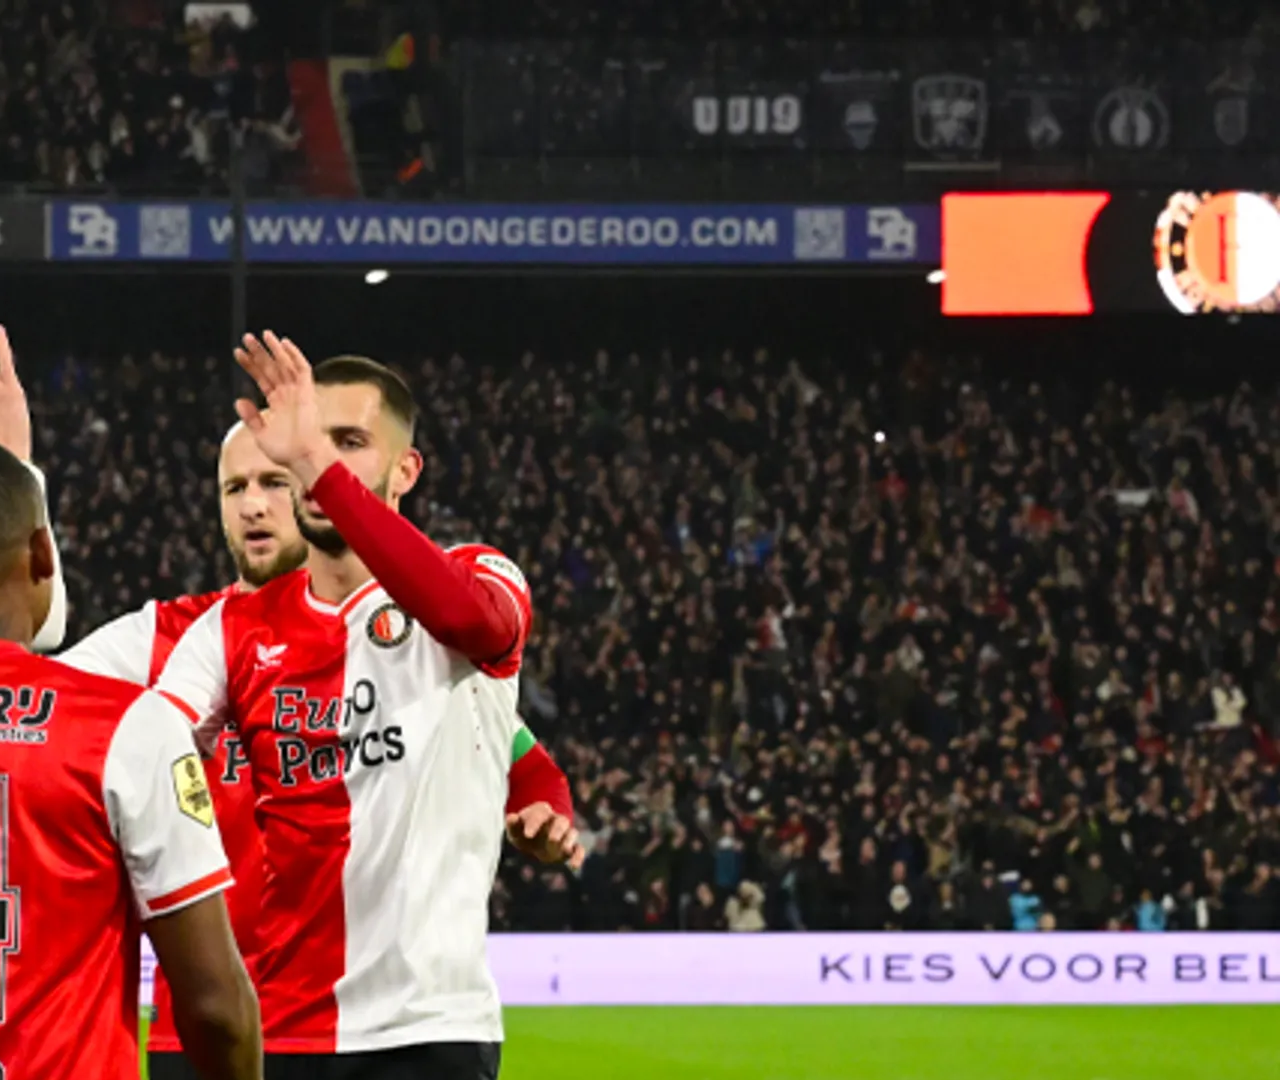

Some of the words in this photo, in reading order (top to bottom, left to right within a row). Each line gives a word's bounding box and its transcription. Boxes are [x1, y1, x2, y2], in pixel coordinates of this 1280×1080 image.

[273, 678, 375, 734] Euro
[276, 726, 405, 786] Parcs
[819, 953, 955, 982] KIES
[979, 953, 1147, 982] VOOR
